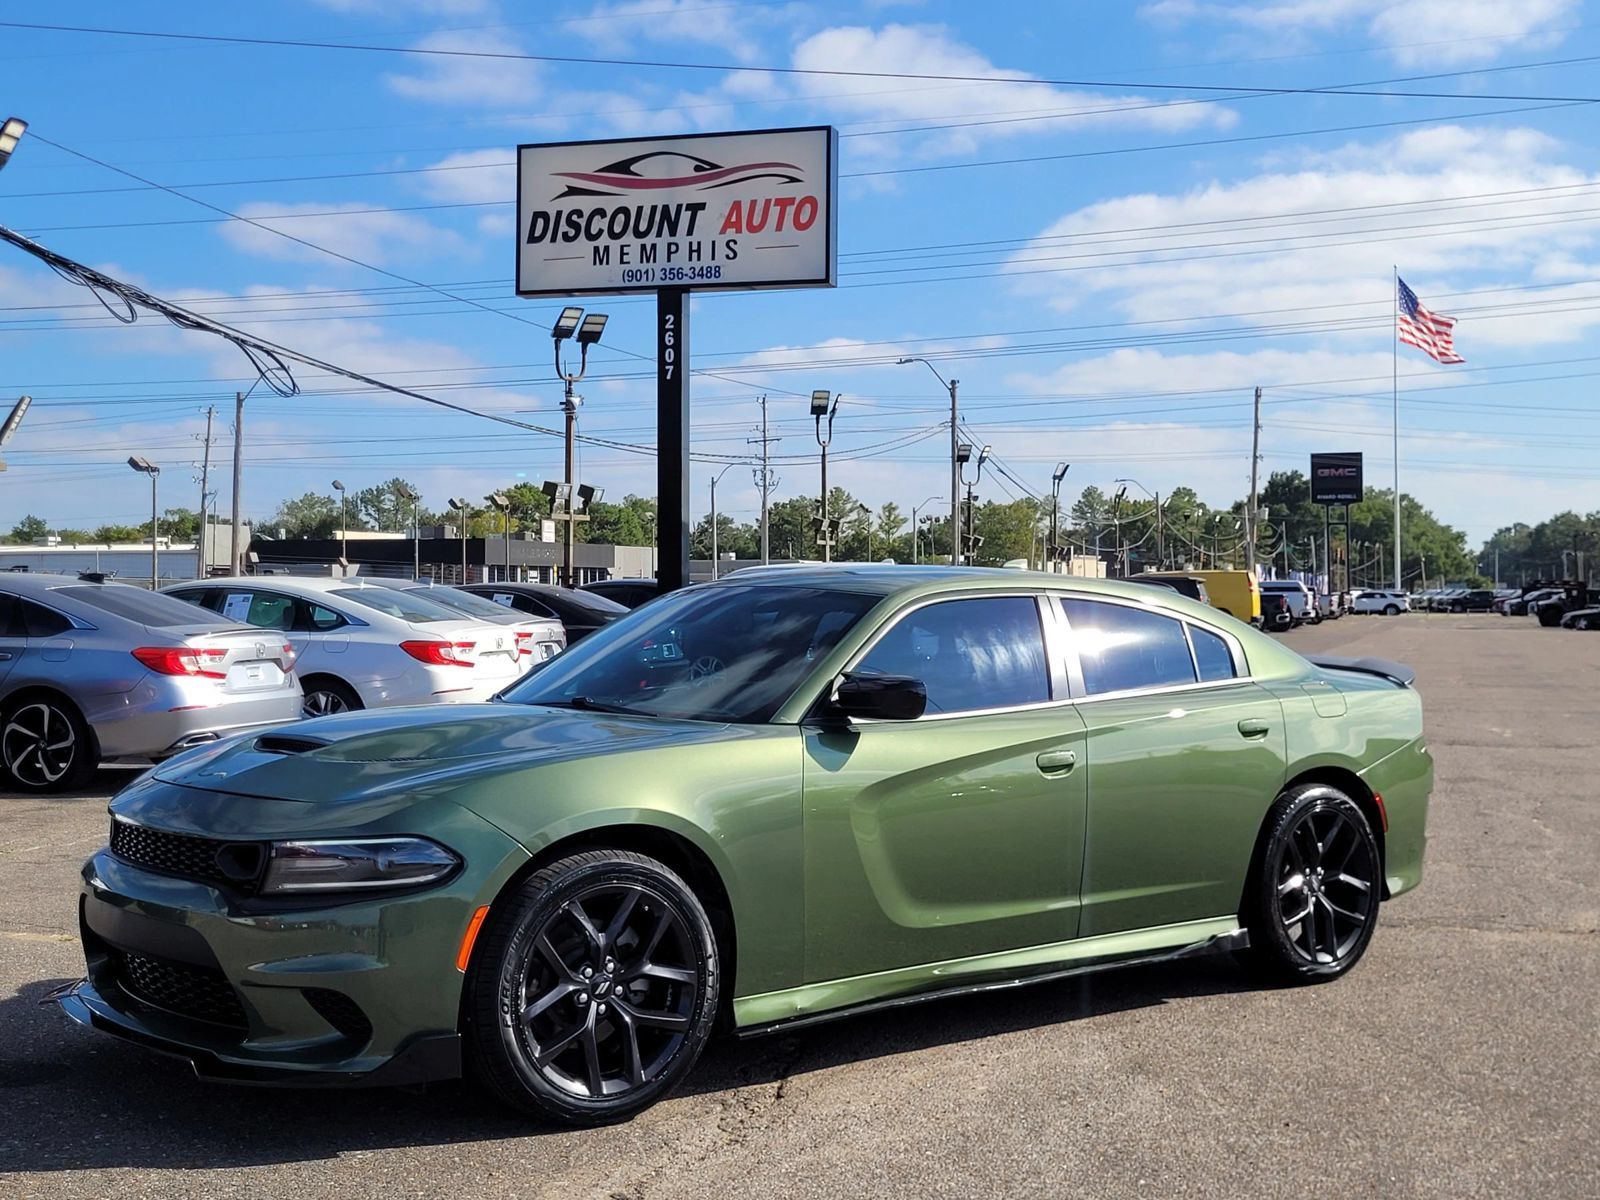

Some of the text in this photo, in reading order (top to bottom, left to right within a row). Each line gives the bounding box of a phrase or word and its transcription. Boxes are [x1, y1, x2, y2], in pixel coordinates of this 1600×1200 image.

[526, 195, 819, 244] DISCOUNT AUTO
[593, 239, 738, 266] MEMPHIS
[621, 265, 721, 284] (901) 356-3488
[664, 314, 674, 380] 2607
[1316, 468, 1357, 477] GMC
